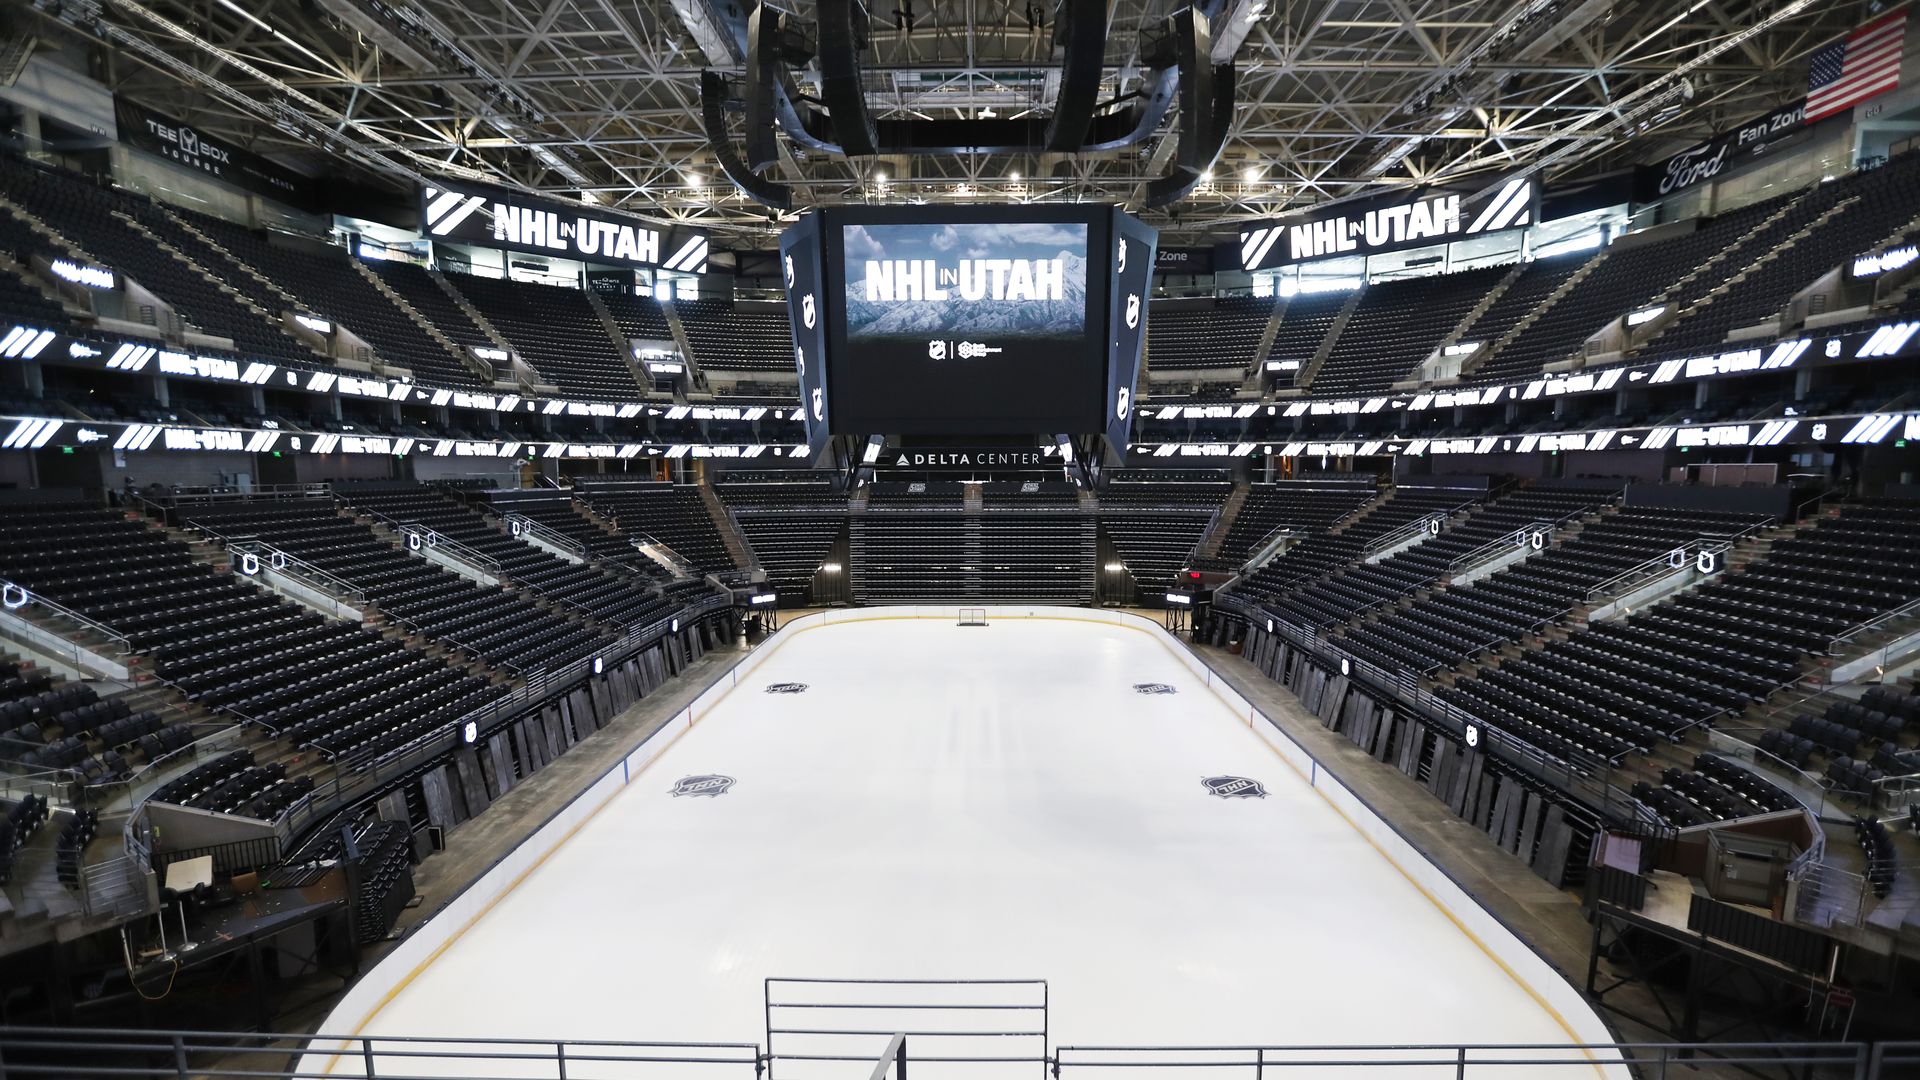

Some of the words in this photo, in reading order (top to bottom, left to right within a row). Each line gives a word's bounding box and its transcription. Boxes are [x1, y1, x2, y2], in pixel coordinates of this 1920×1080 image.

[146, 119, 179, 143] TEE
[199, 141, 231, 165] BOX
[1738, 123, 1768, 145] Fan
[162, 146, 221, 175] LOUNGE
[1659, 143, 1728, 194] Ford
[493, 204, 567, 250] NHL
[560, 222, 576, 239] IN
[576, 217, 659, 264] UTAH
[1291, 217, 1356, 259] NHL
[1349, 221, 1364, 237] IN
[1366, 195, 1460, 245] UTAH
[1159, 251, 1188, 261] Zone
[865, 260, 949, 302] NHL
[939, 268, 958, 286] IN
[959, 259, 1063, 301] UTAH
[914, 453, 970, 465] DELTA
[976, 453, 1040, 465] CENTER
[1219, 780, 1249, 793] NHL
